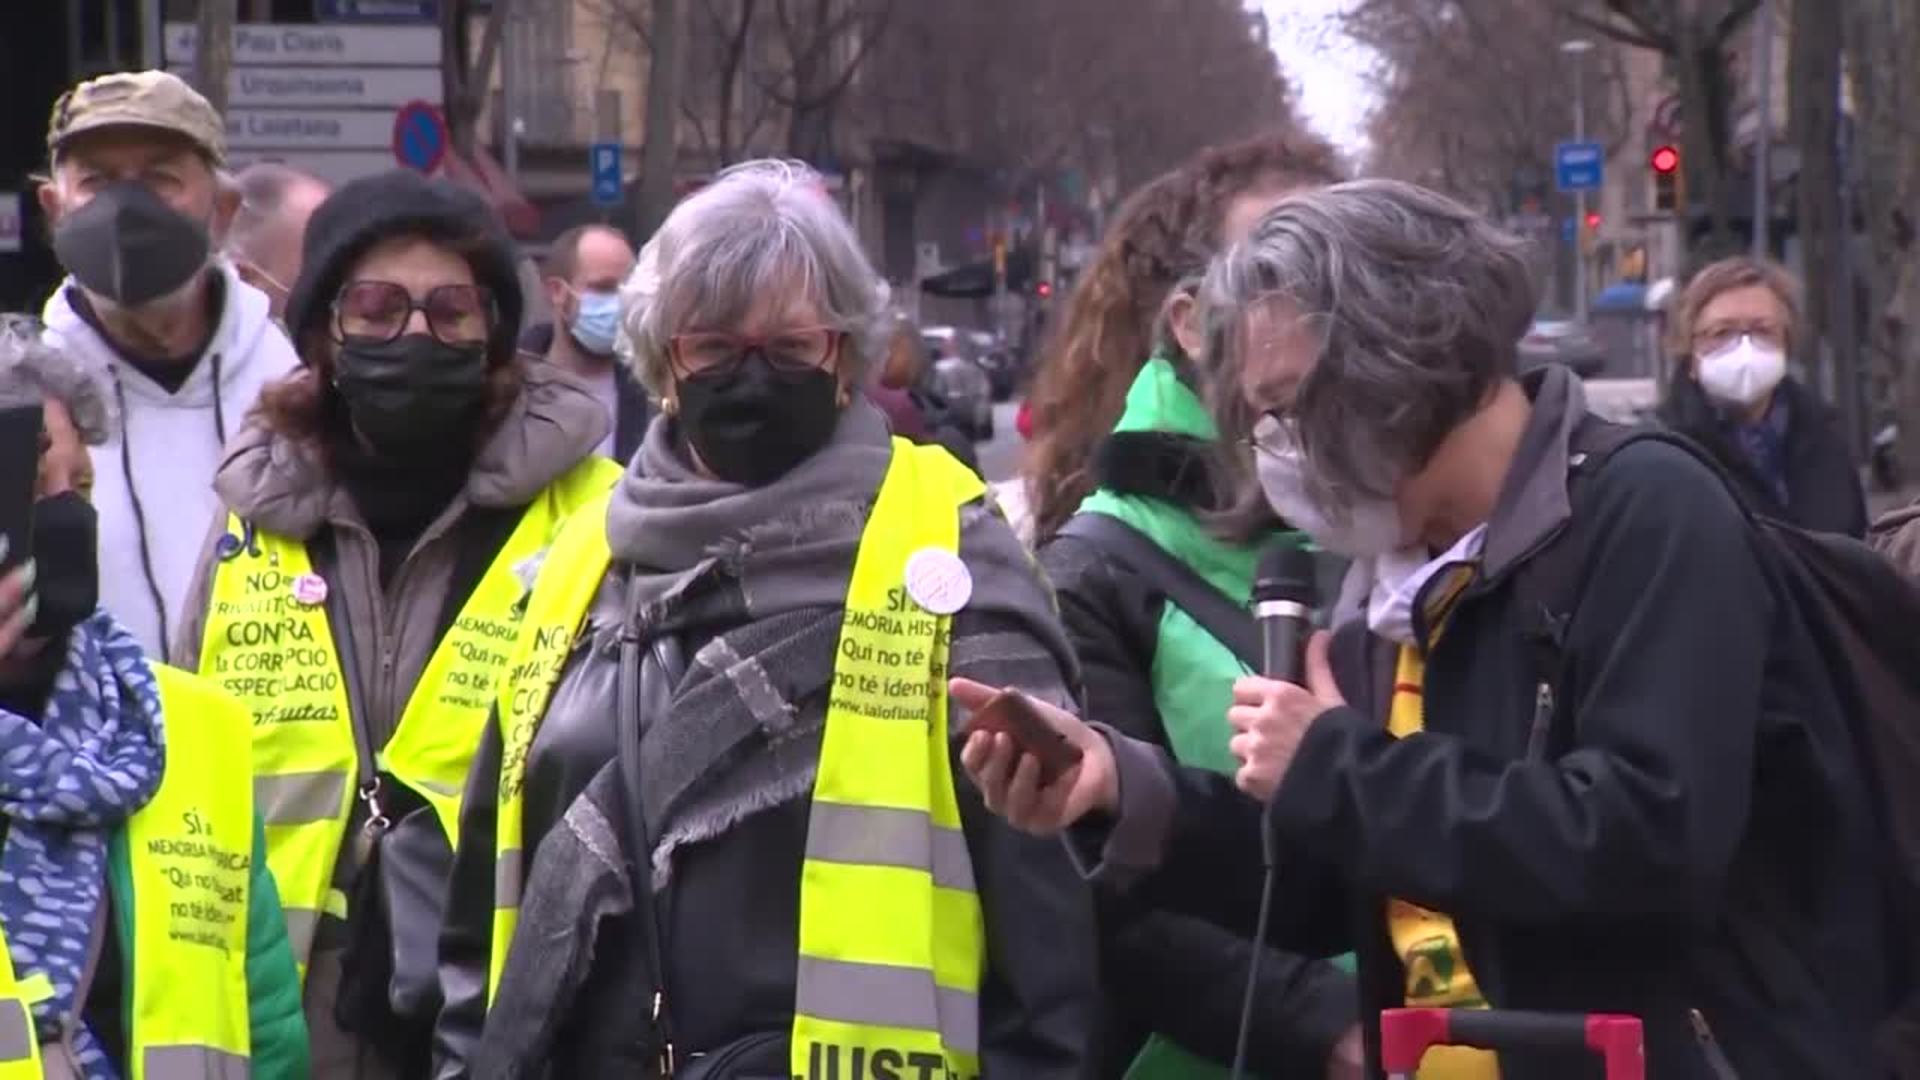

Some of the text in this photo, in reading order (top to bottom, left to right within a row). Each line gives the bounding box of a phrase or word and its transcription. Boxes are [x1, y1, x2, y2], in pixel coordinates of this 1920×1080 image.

[236, 32, 345, 51] Pau Claris
[249, 117, 341, 137] Laietana
[598, 149, 614, 172] P
[246, 571, 281, 593] NO
[843, 608, 904, 636] EMÒRIA
[877, 652, 901, 667] no
[905, 649, 924, 667] té
[447, 671, 468, 686] no
[859, 674, 878, 694] té
